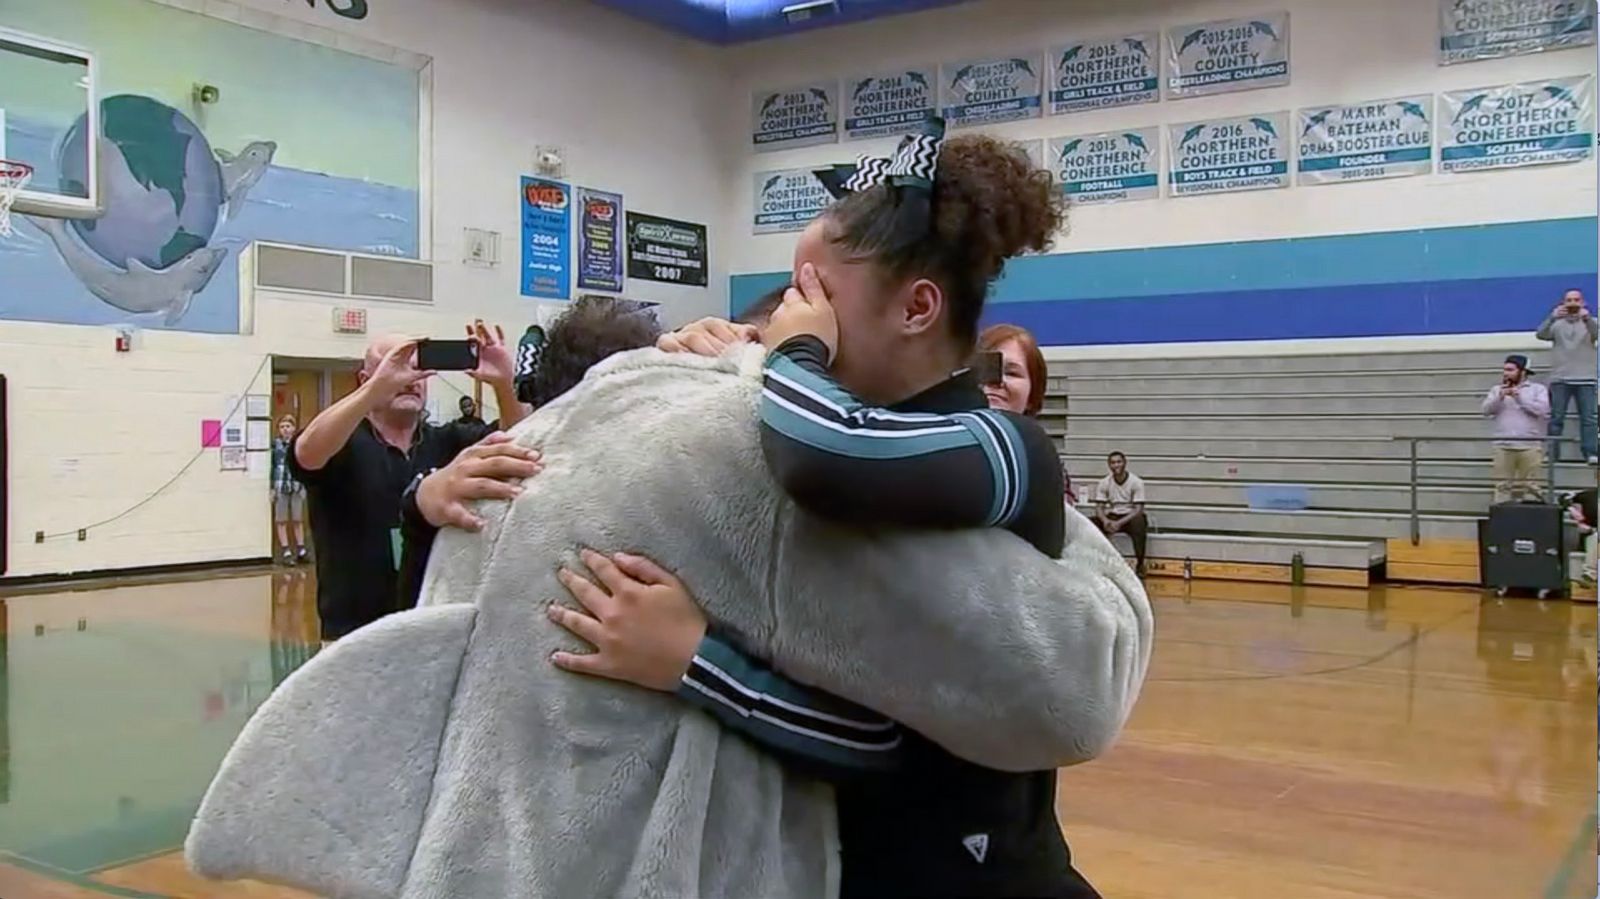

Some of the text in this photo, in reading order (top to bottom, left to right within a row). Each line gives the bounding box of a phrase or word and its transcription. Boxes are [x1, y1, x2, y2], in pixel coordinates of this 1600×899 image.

[1088, 45, 1117, 59] 2015
[1206, 41, 1249, 56] WAKE
[1065, 54, 1142, 75] NORTHERN
[1195, 52, 1260, 72] COUNTY
[1060, 65, 1148, 87] CONFERENCE
[859, 86, 922, 104] NORTHERN
[965, 86, 1020, 103] COUNTY
[1086, 86, 1114, 97] TRACK
[766, 101, 825, 120] NORTHERN
[853, 97, 927, 116] CONFERENCE
[1495, 94, 1535, 110] 2017
[1341, 104, 1387, 120] MARK
[1463, 106, 1568, 129] NORTHERN
[761, 112, 828, 131] CONFERENCE
[1328, 118, 1400, 138] BATEMAN
[1211, 124, 1243, 139] 2016
[1455, 120, 1577, 144] CONFERENCE
[1088, 138, 1117, 153] 2015
[1186, 135, 1270, 155] NORTHERN
[1300, 131, 1430, 156] DRMS BOOSTER CLUB
[1485, 141, 1543, 156] SOFTBALL
[1065, 150, 1141, 168] NORTHERN
[1180, 147, 1277, 169] CONFERENCE
[1339, 153, 1387, 166] FOUNDER
[1059, 162, 1147, 181] CONFERENCE
[1183, 165, 1273, 182] BOYS TRACK & FIELD
[767, 186, 826, 200] NORTHERN
[1080, 180, 1123, 191] FOOTBALL
[763, 195, 830, 212] CONFERENCE
[654, 265, 681, 280] 2007
